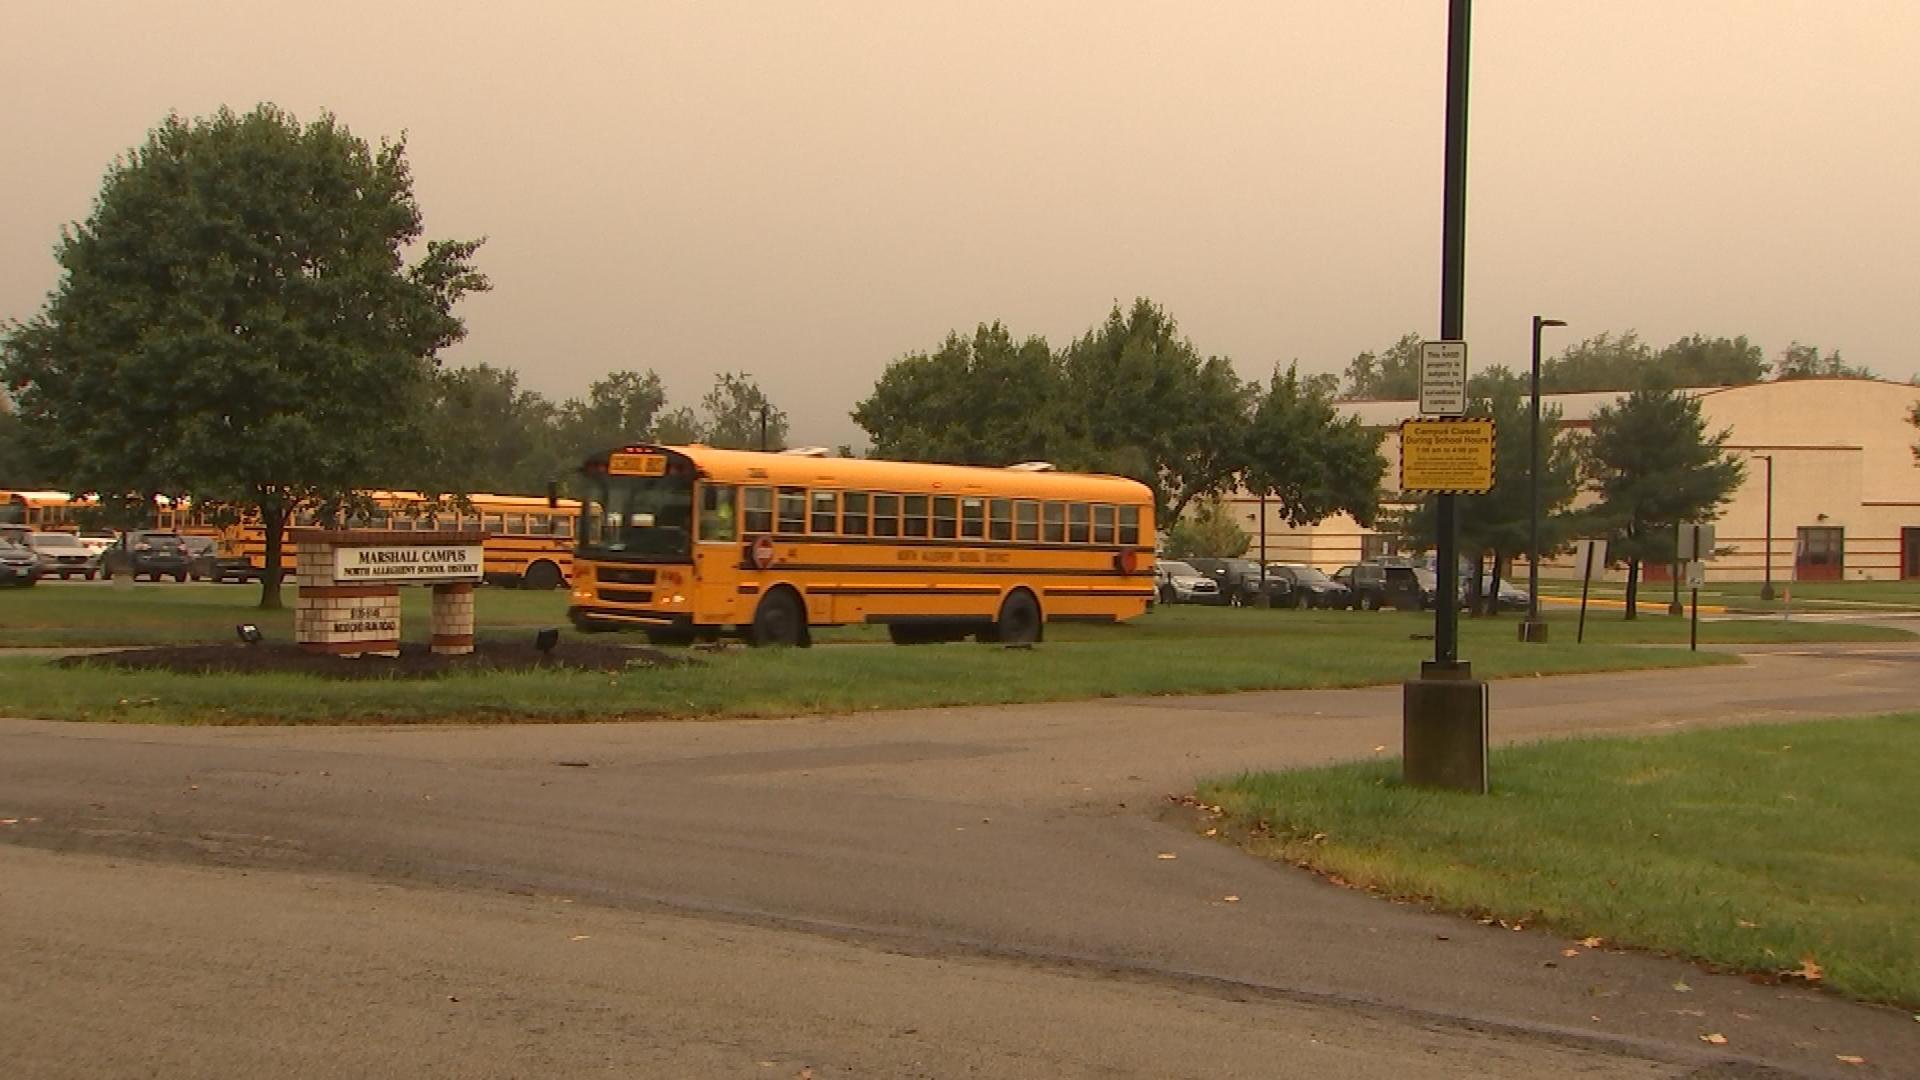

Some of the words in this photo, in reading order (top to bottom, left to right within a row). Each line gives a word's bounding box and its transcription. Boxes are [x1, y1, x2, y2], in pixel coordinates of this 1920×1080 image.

[1414, 427, 1449, 437] Campus
[1406, 436, 1433, 445] During
[1435, 436, 1463, 444] School
[358, 551, 419, 564] MARSHALL
[422, 550, 466, 562] CAMPUS
[343, 567, 370, 576] NORTH
[372, 565, 416, 575] ALLEGHENY
[417, 565, 444, 573] SCHOOL
[447, 563, 479, 573] DISTRICT
